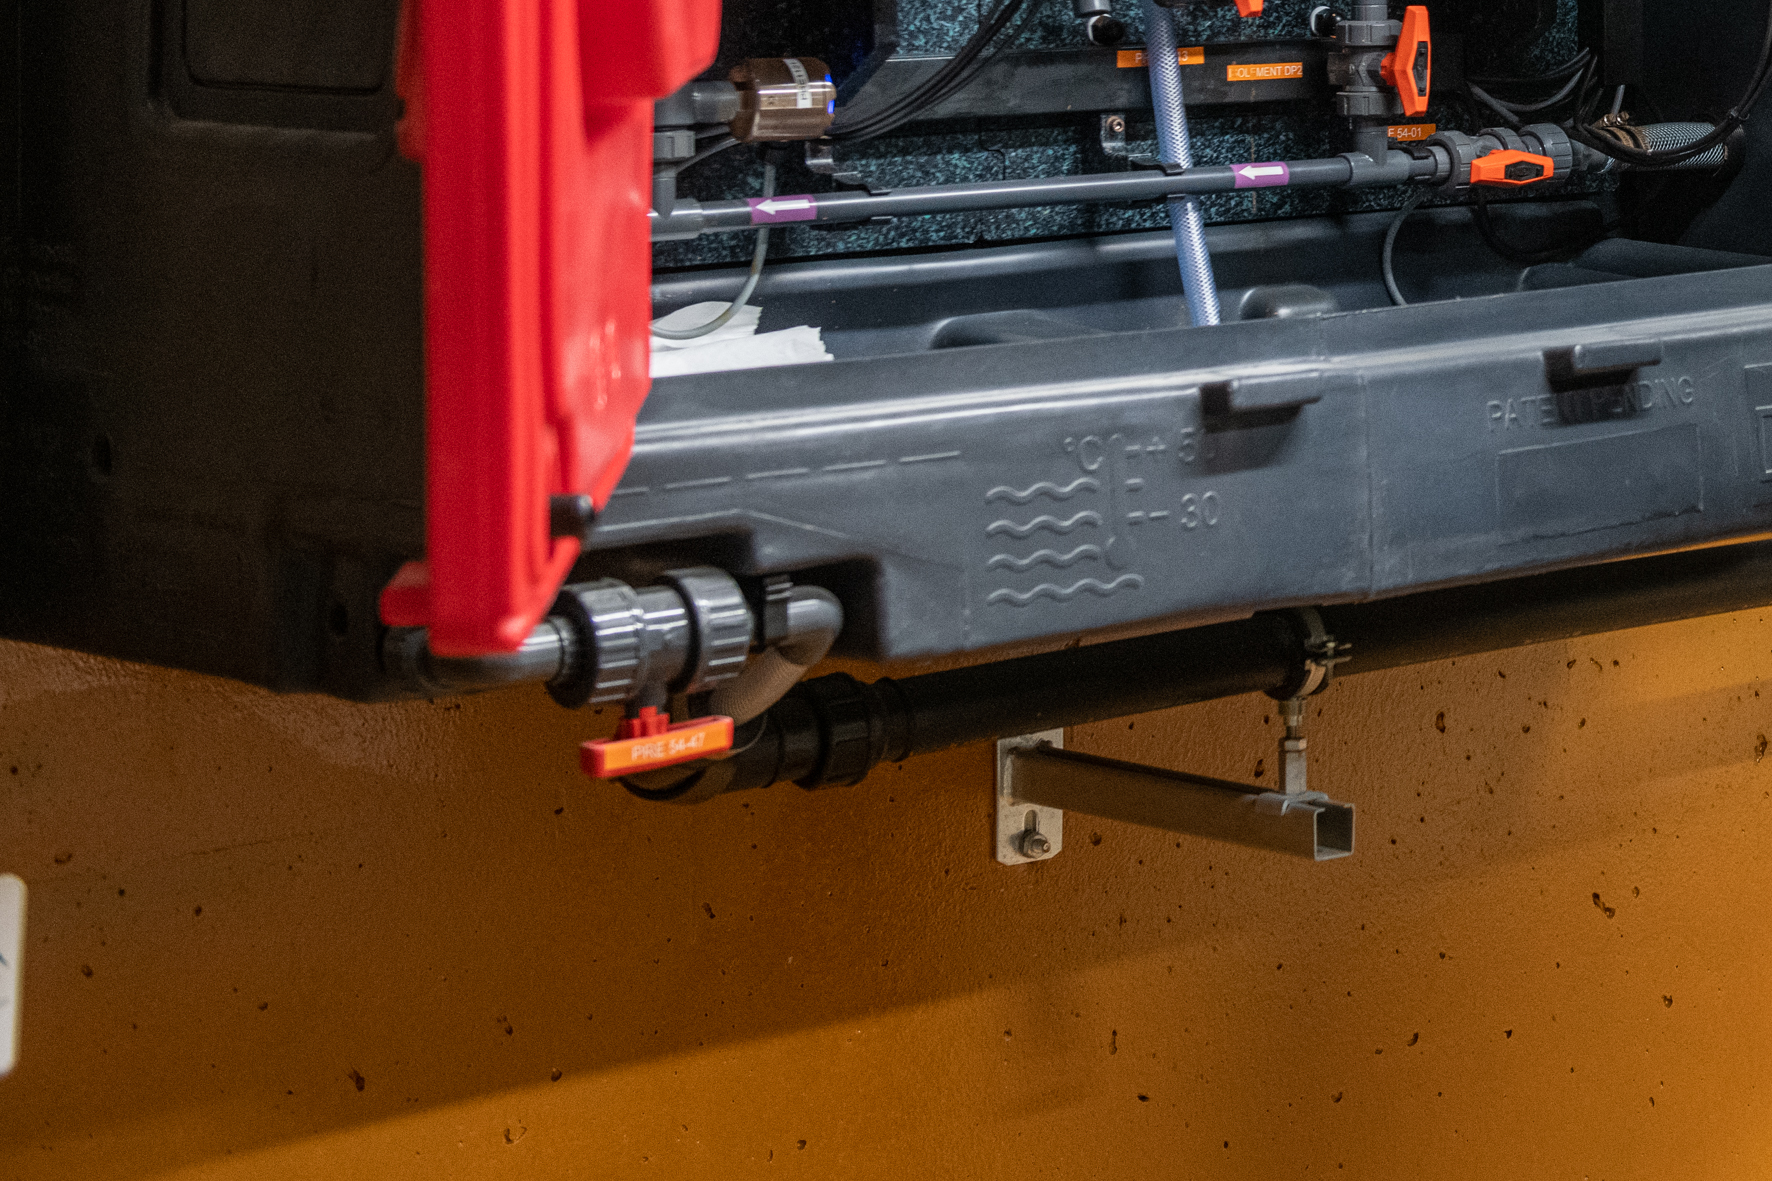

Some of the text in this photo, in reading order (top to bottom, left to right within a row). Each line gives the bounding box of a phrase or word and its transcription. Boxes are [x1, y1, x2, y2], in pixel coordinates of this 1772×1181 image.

[1284, 66, 1303, 76] DP2
[1397, 127, 1422, 138] 54-01
[631, 741, 665, 761] PRE
